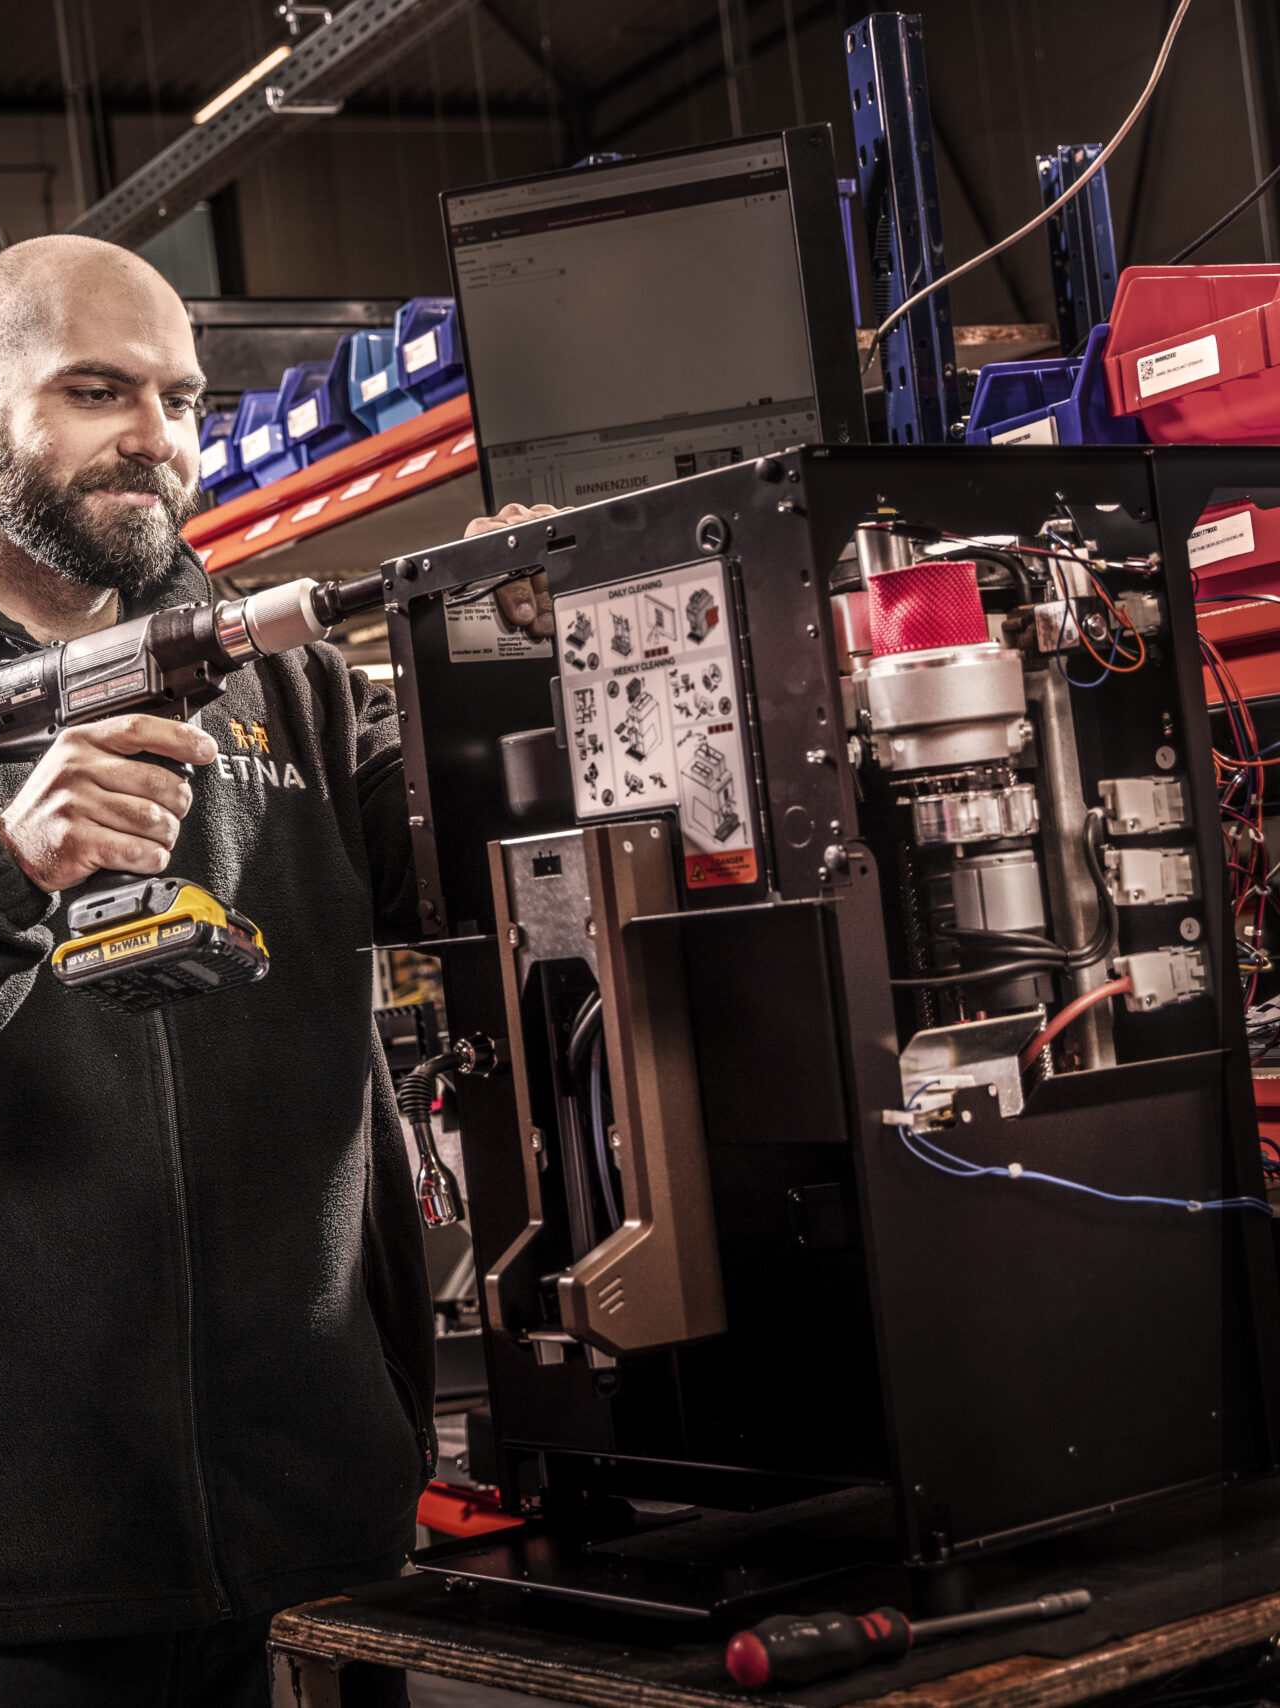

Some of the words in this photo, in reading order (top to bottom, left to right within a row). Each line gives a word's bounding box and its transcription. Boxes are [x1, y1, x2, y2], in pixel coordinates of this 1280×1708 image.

[575, 475, 649, 496] BINNENZIJDE
[608, 586, 627, 599] DAILY
[628, 579, 663, 595] CLEANING
[612, 663, 640, 677] WEEKLY
[640, 656, 676, 671] CLEANING
[1160, 752, 1167, 763] 1
[216, 753, 307, 789] ETNA
[1185, 923, 1194, 934] 2
[85, 949, 101, 961] XR
